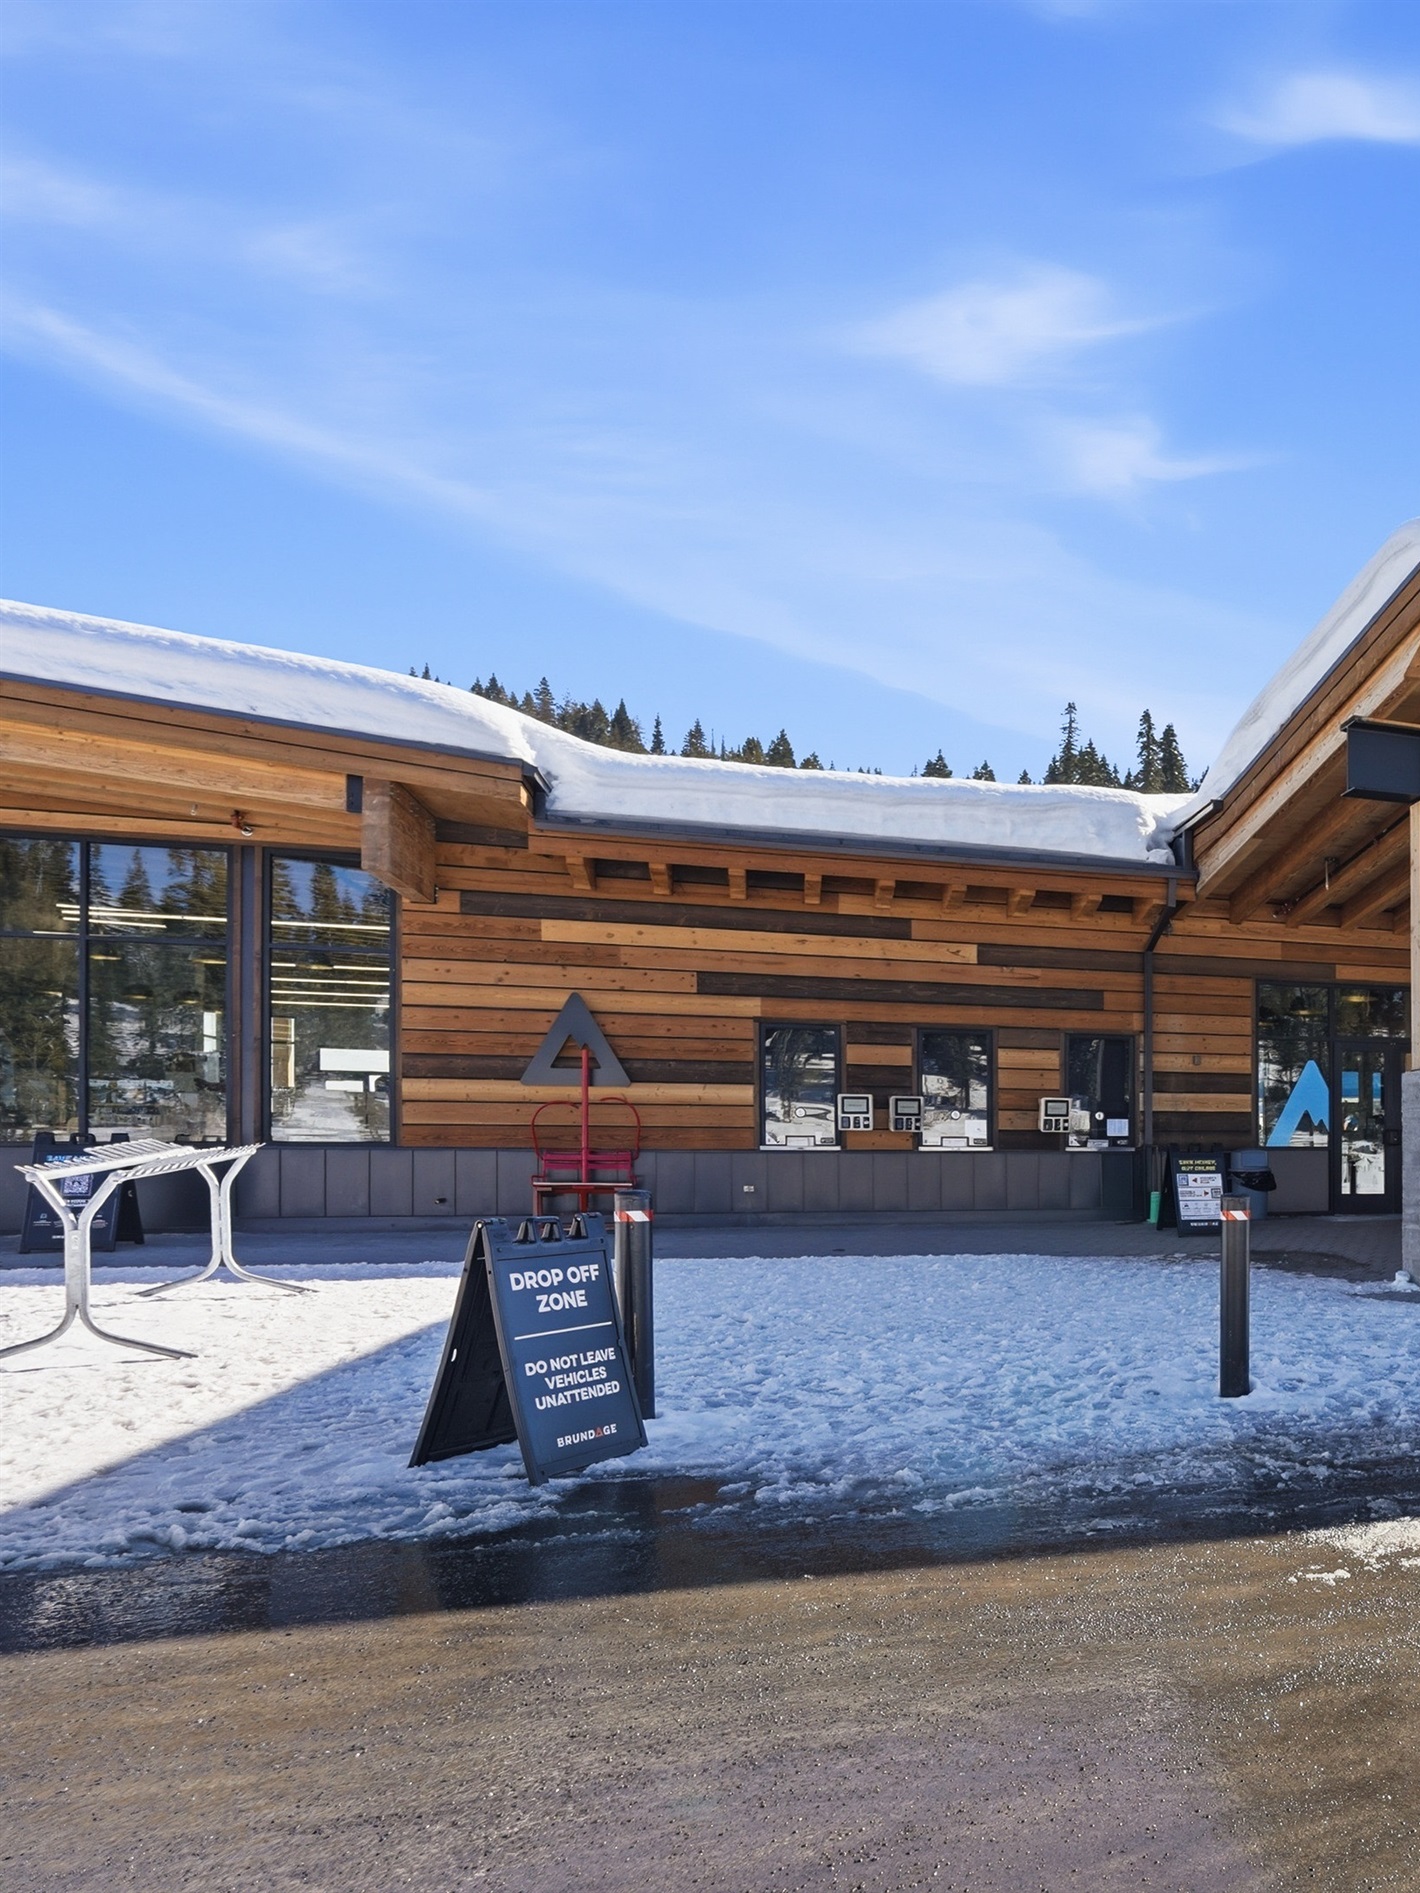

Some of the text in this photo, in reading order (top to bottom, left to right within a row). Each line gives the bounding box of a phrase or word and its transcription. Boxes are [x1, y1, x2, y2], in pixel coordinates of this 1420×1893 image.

[509, 1263, 599, 1291] DROP OFF
[536, 1289, 588, 1313] ZONE
[525, 1347, 616, 1376] DO NOT LEAVE
[544, 1366, 607, 1390] VEHICLES
[534, 1380, 620, 1410] UNATTENDED
[556, 1423, 617, 1448] BRUNDAGE
